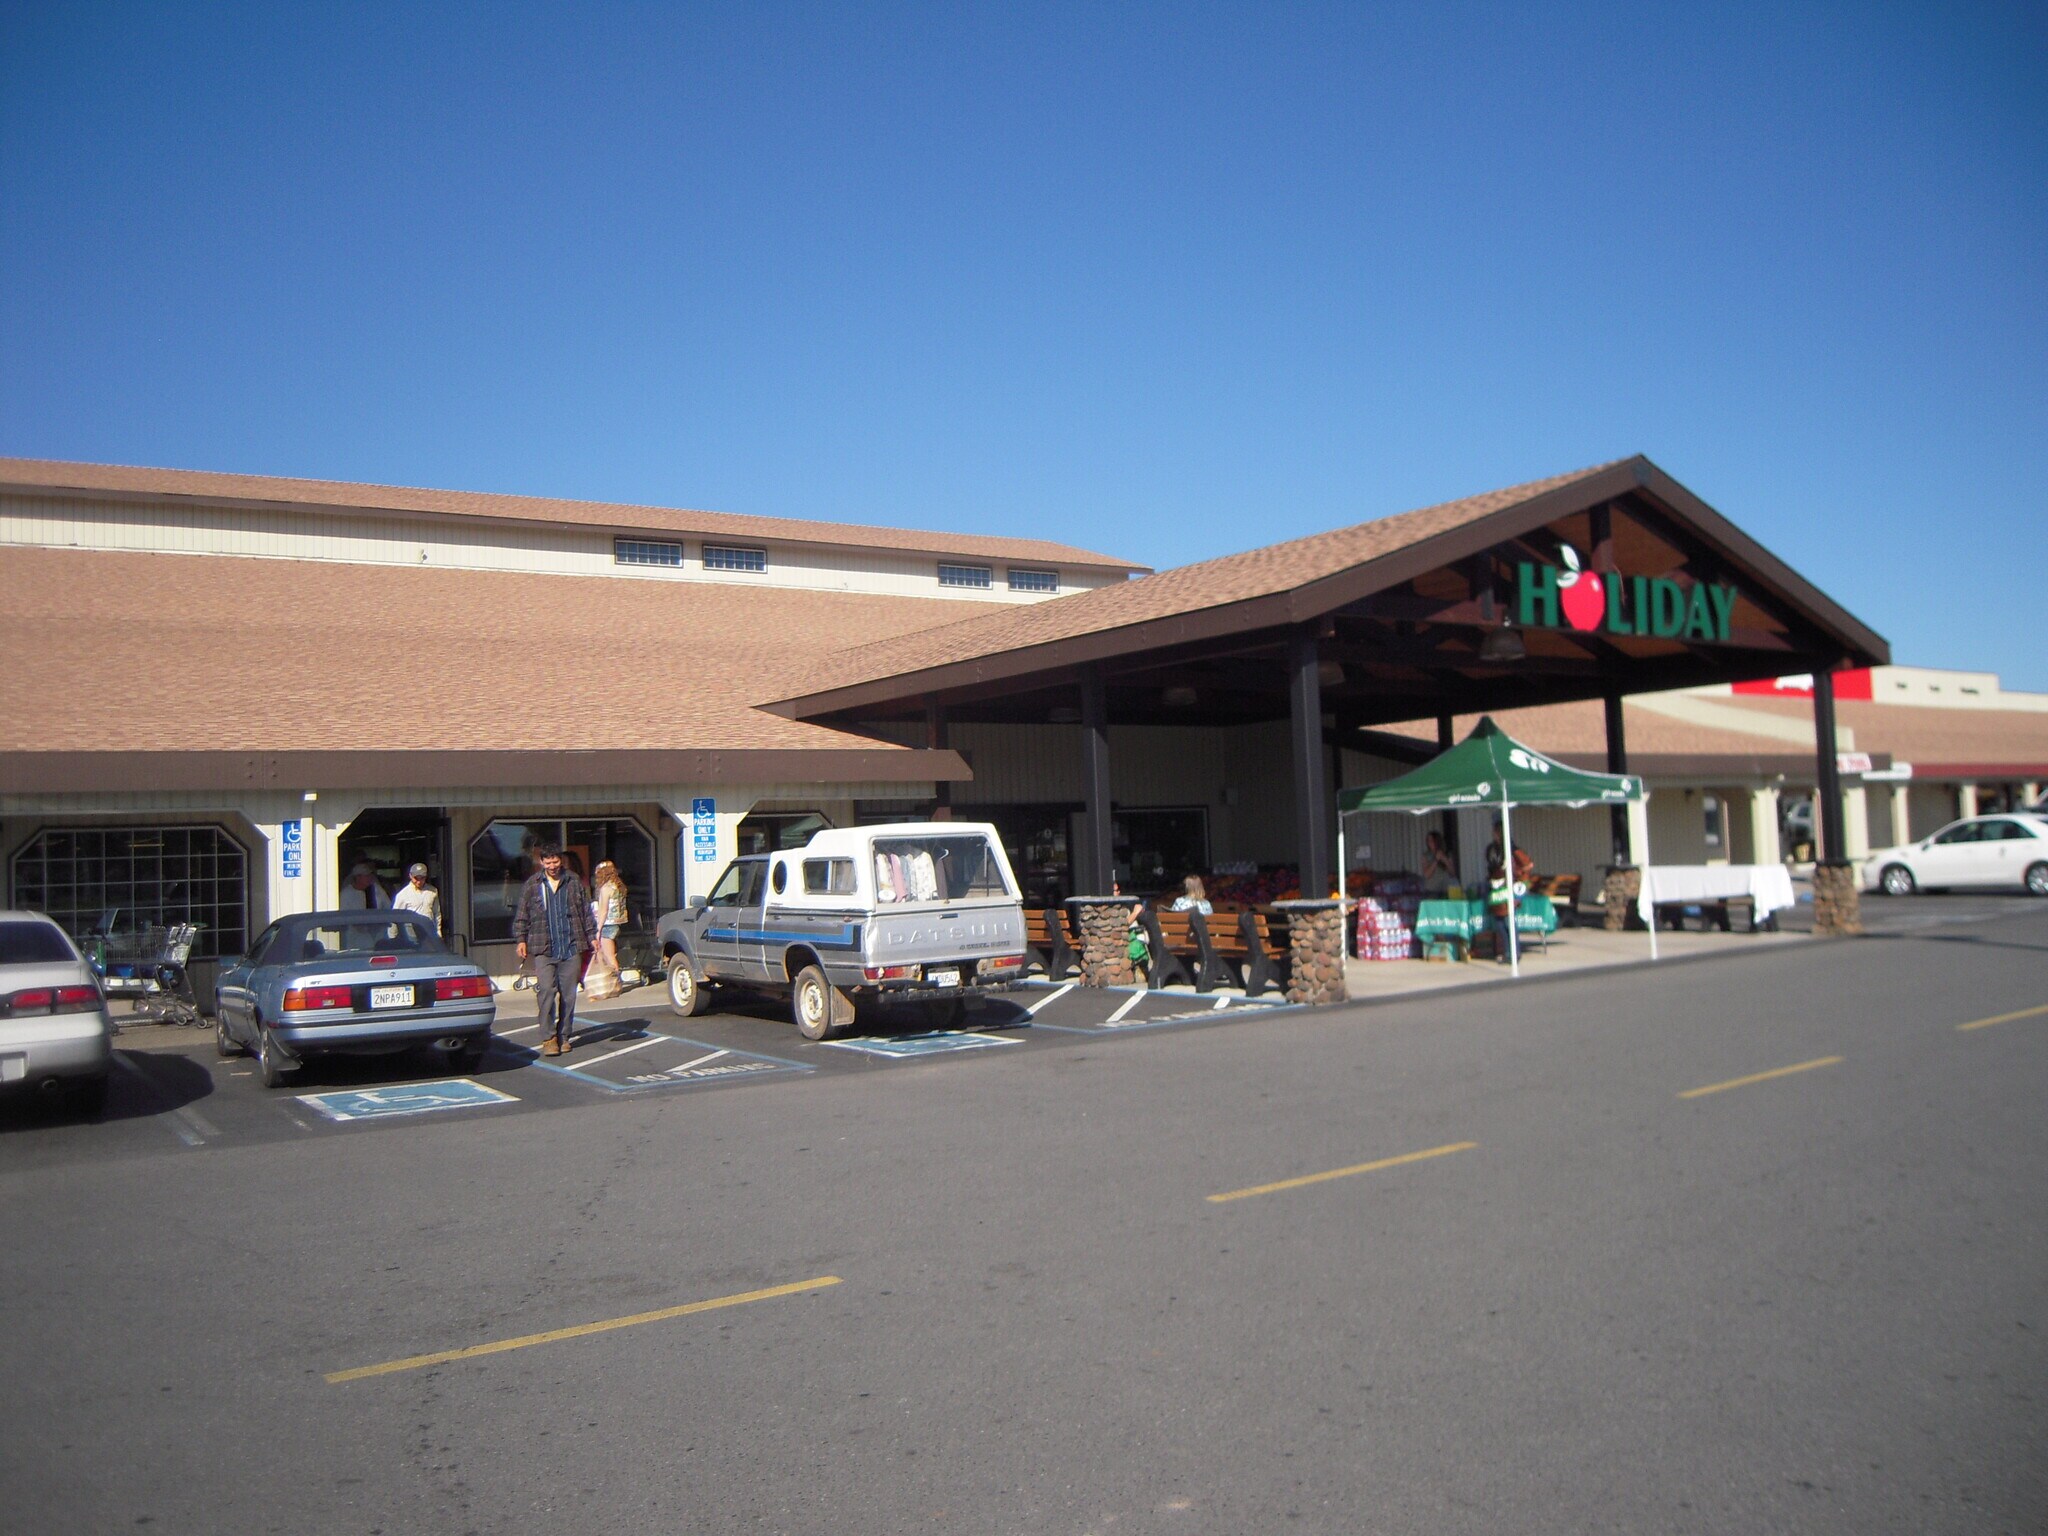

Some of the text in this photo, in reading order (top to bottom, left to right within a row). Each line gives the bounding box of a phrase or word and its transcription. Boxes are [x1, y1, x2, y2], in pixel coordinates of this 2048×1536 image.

[1518, 560, 1738, 641] HOLIDAY
[694, 818, 715, 826] PARKING
[697, 826, 711, 834] ONLY
[283, 842, 301, 851] PARK
[288, 852, 301, 861] ONL
[374, 991, 412, 1005] 2NPA911
